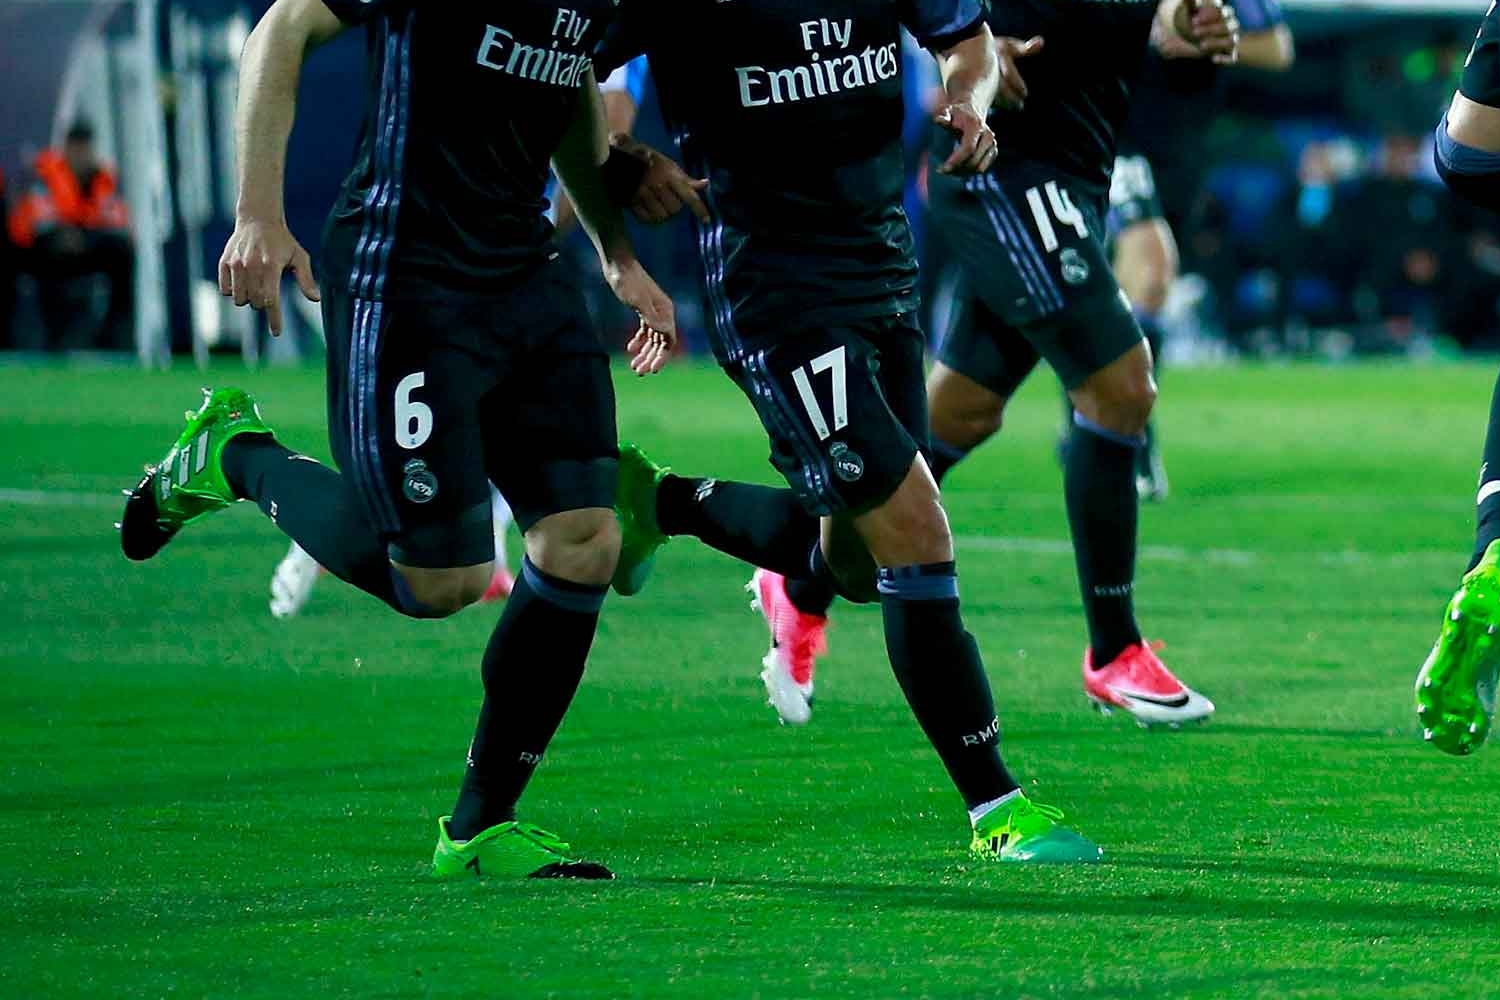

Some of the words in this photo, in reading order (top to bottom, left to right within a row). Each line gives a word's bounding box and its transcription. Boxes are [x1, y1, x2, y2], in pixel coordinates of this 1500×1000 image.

[476, 23, 592, 88] Emirate
[551, 7, 592, 47] Fly
[800, 18, 852, 51] Fly
[734, 42, 898, 108] Emirates
[1025, 180, 1089, 254] 14
[394, 371, 434, 450] 6
[791, 345, 849, 441] 17
